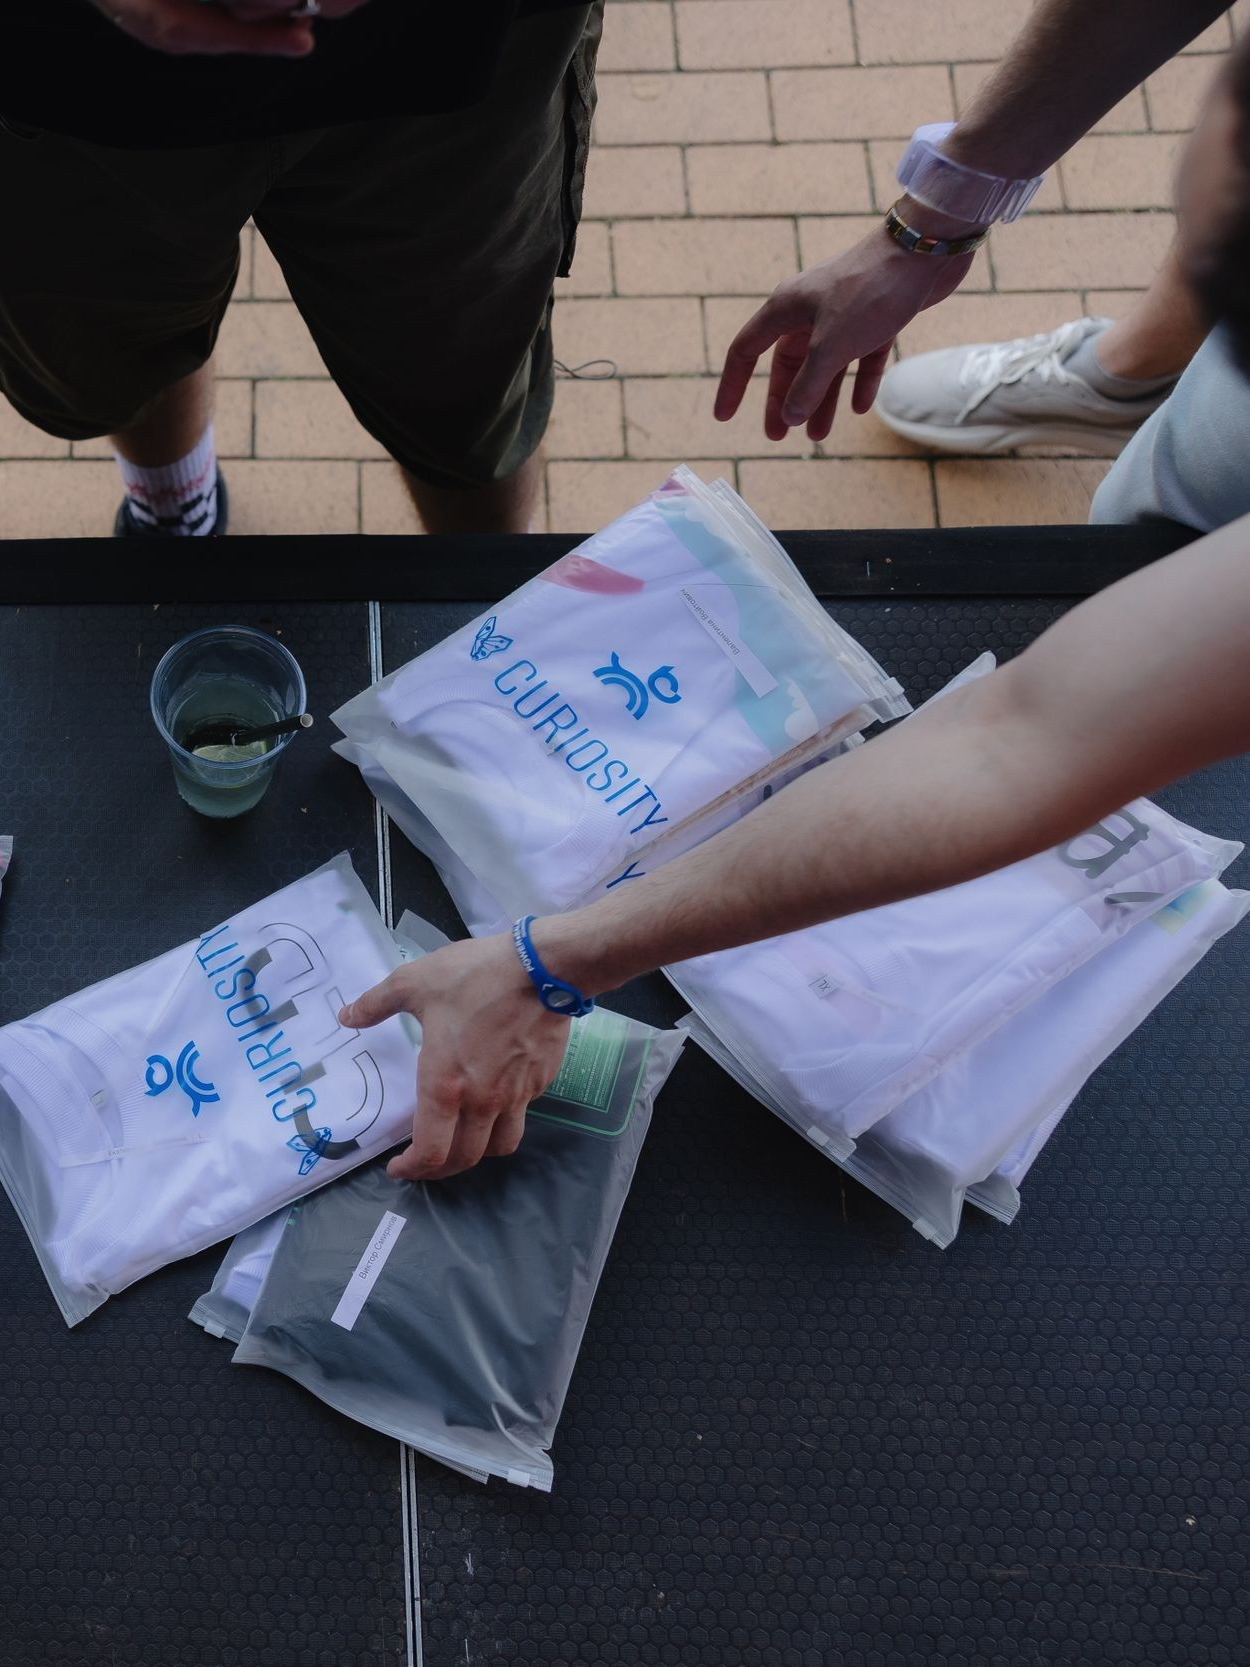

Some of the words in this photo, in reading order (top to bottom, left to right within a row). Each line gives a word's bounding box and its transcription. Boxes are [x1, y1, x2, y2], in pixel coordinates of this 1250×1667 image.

[707, 619, 741, 656] Валентина
[494, 659, 669, 835] CURIOSITY
[515, 938, 536, 973] POWER
[196, 925, 317, 1122] CURIOSITY
[358, 1251, 379, 1280] Виктор
[374, 1215, 398, 1251] Смирнов
